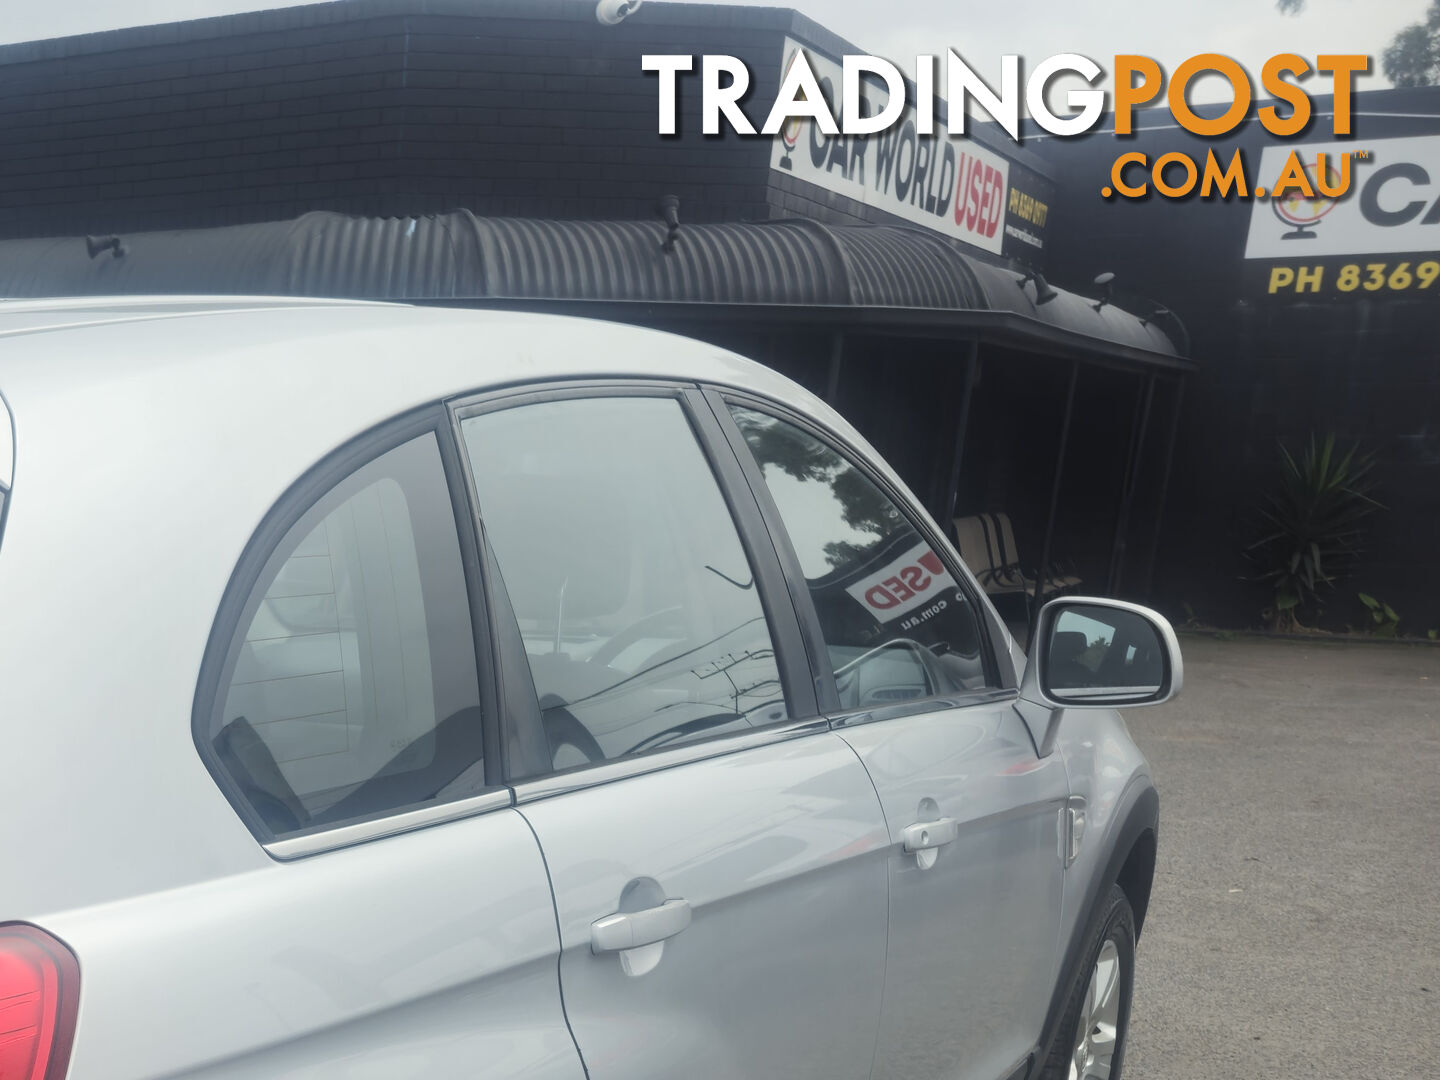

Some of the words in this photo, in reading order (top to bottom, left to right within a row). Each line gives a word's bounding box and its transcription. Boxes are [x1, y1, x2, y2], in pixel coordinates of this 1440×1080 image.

[875, 104, 955, 218] WORLD
[954, 152, 1003, 239] USED
[1360, 162, 1440, 227] C
[1268, 266, 1324, 294] PH
[1336, 261, 1440, 293] 8369
